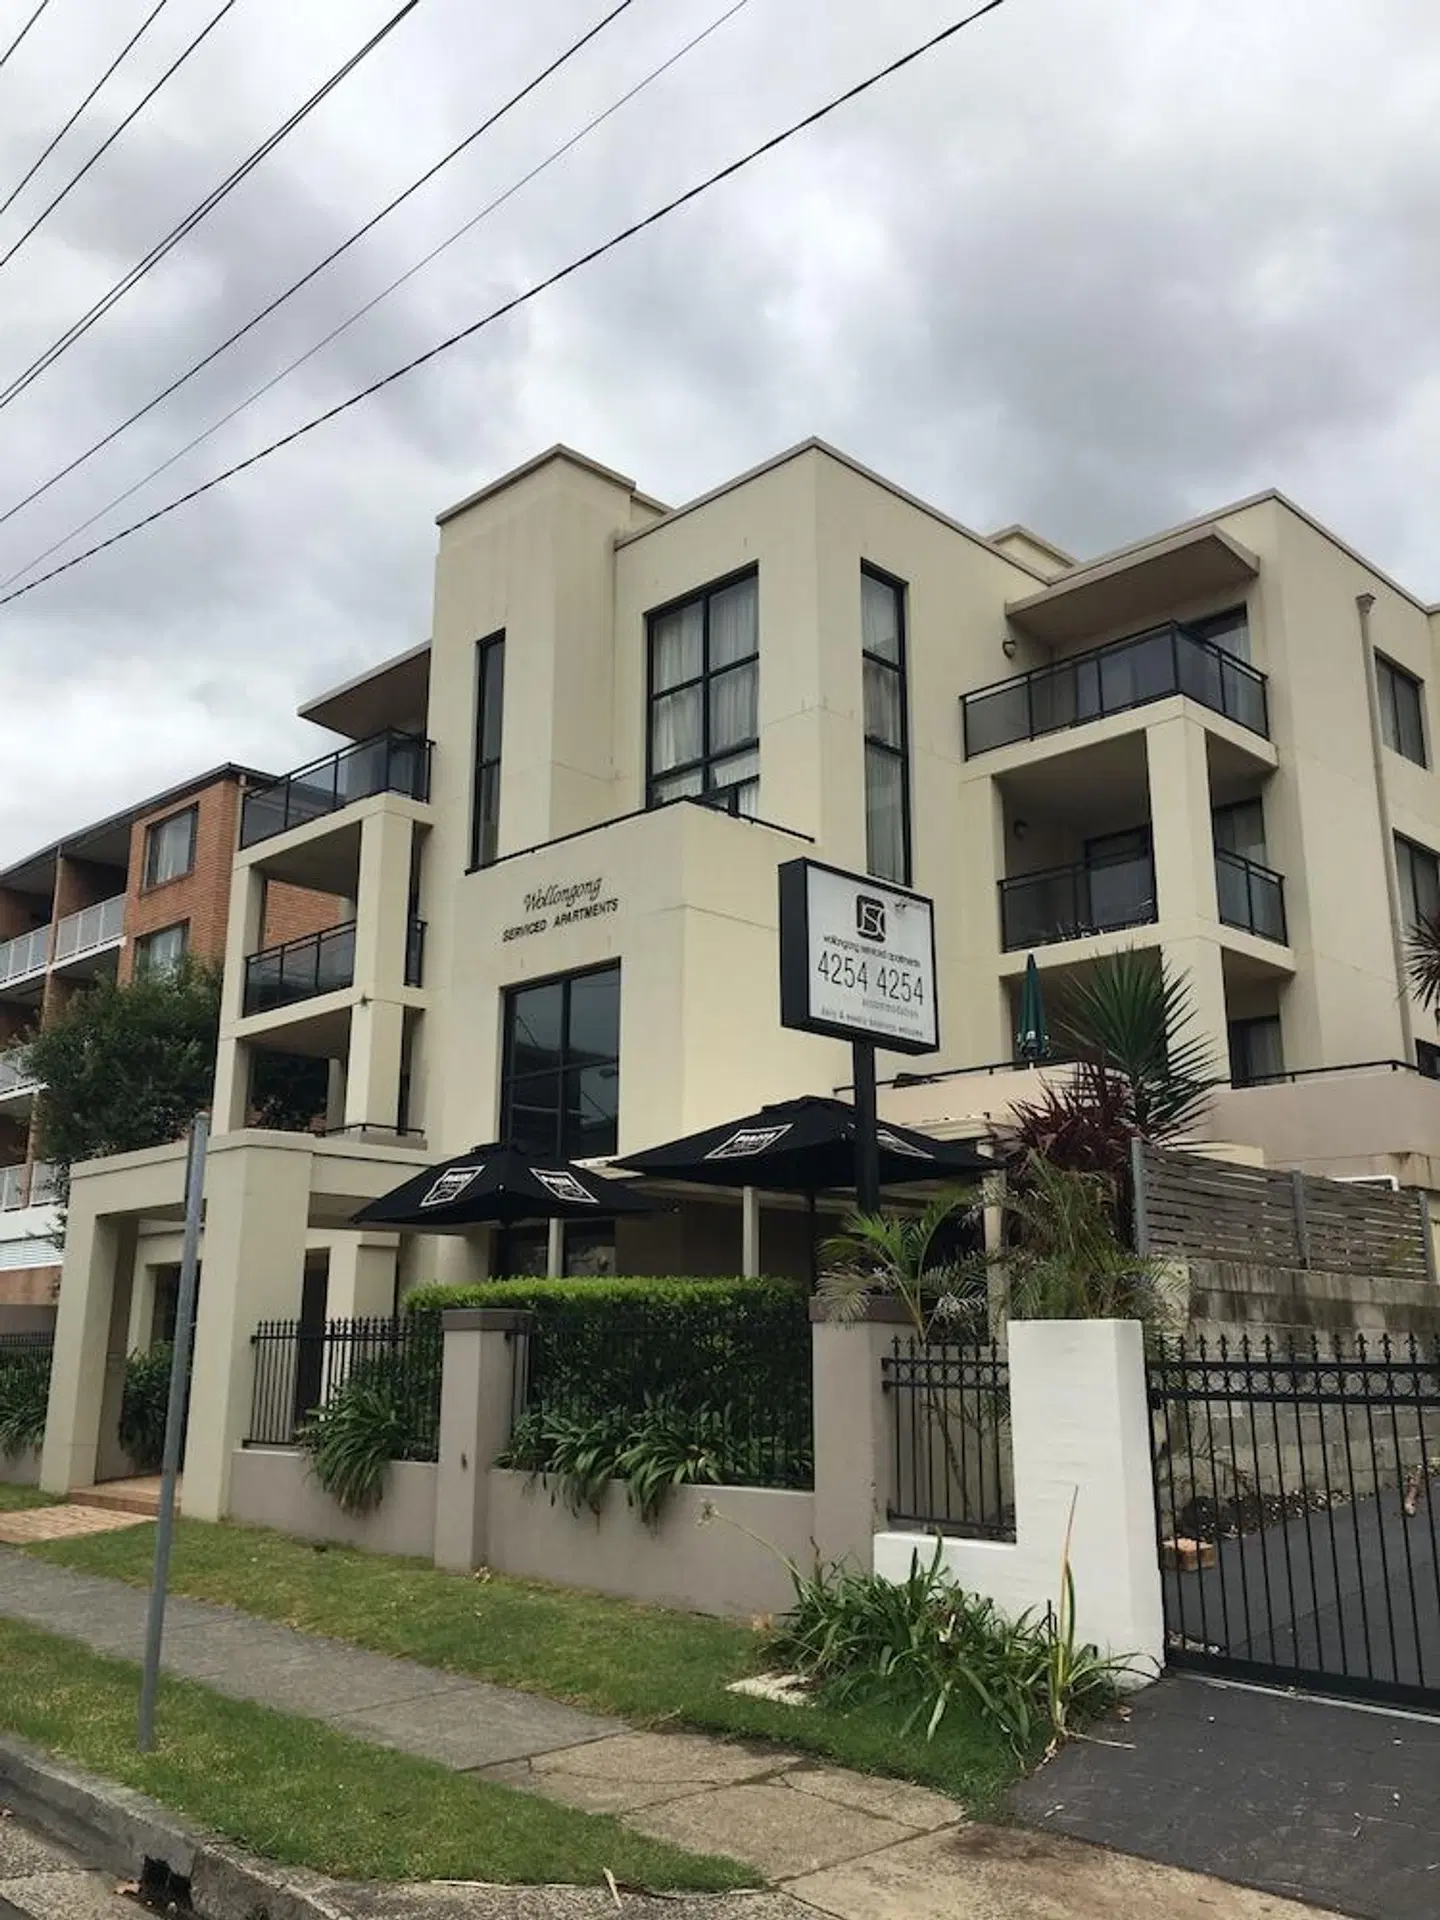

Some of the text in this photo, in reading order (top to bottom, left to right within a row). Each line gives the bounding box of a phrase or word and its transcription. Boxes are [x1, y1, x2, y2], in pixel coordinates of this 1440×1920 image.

[523, 877, 603, 913] Wollongong
[502, 898, 619, 942] SERVICED APARTMENTS
[817, 950, 924, 1006] 4254 4254
